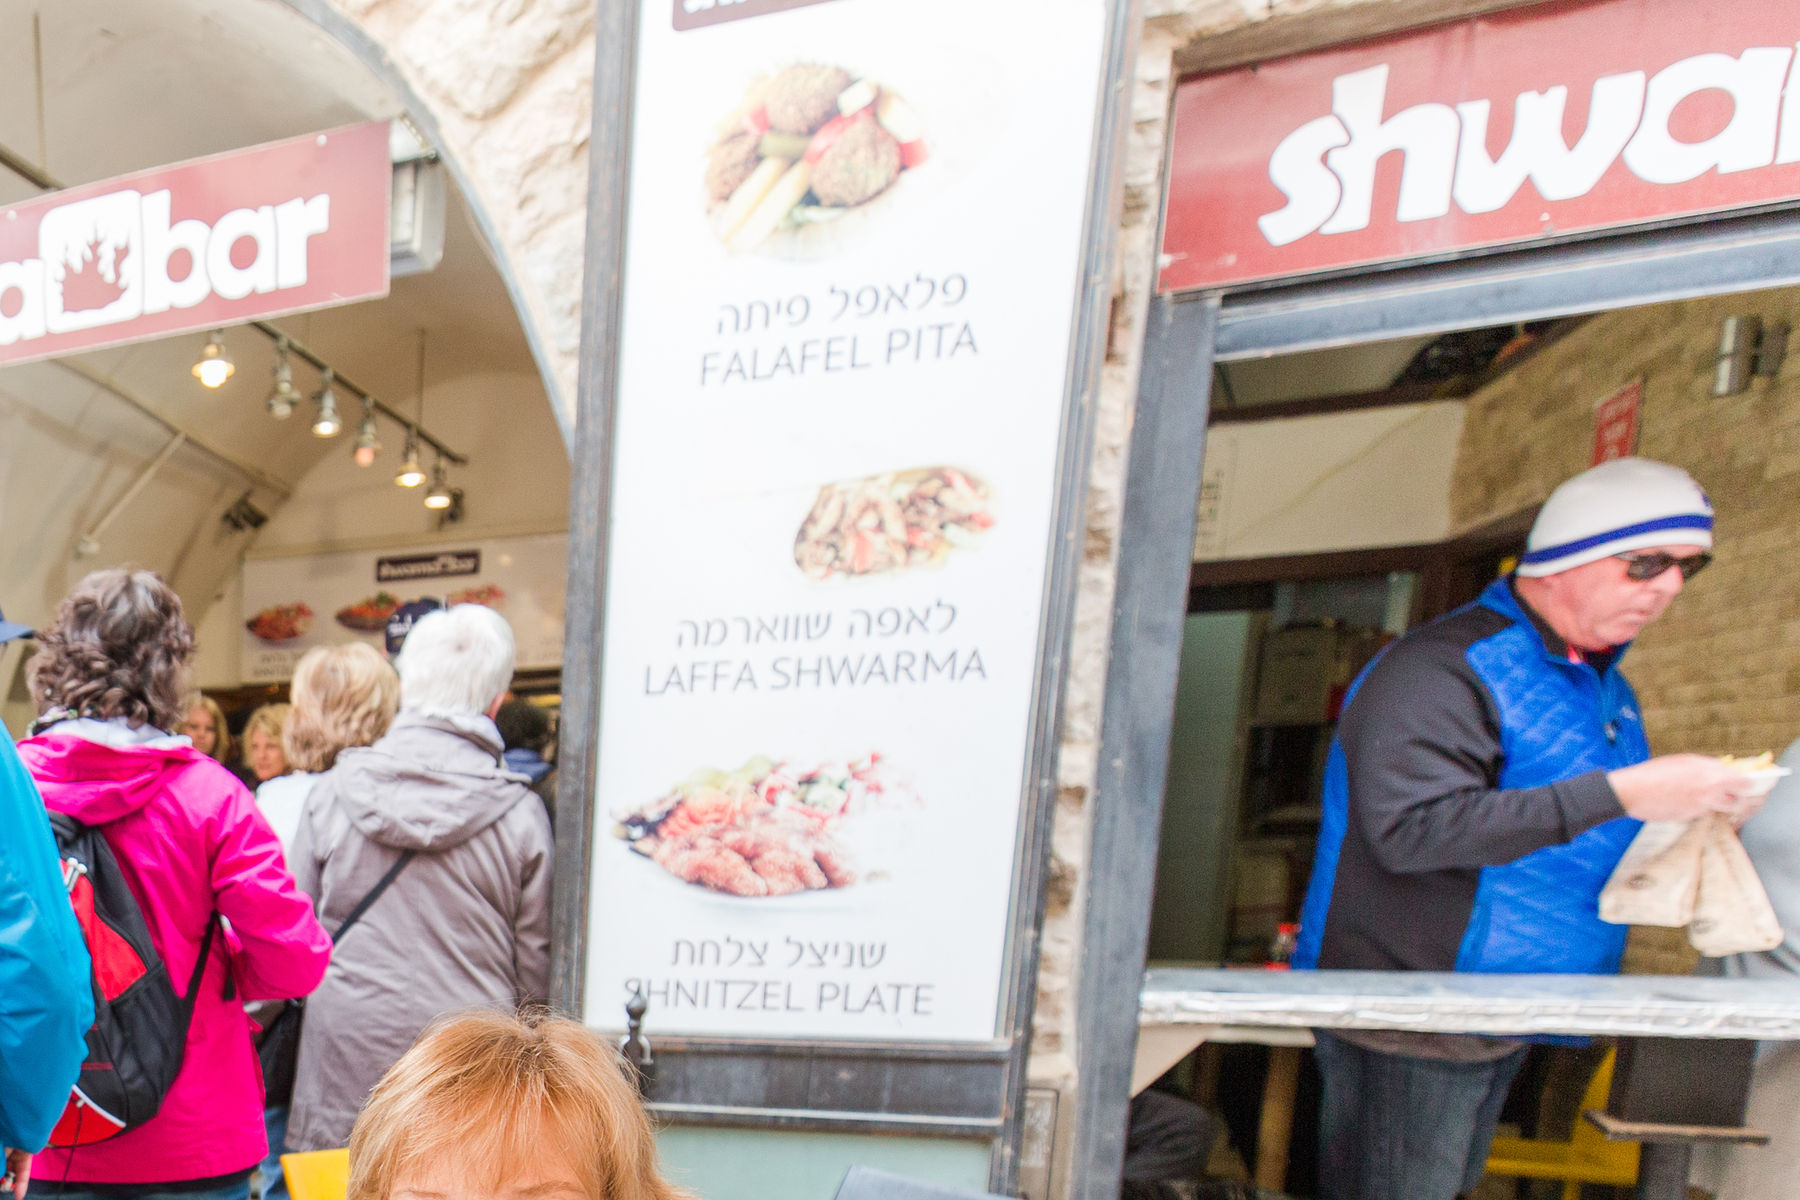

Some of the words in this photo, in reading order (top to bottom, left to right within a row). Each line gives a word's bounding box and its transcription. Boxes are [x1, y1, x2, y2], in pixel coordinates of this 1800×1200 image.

[143, 190, 330, 313] bar
[715, 294, 813, 336] פיתה
[830, 271, 969, 321] פלאפל
[699, 334, 872, 388] FALAFEL
[885, 321, 980, 366] PITA
[675, 610, 833, 651] שווארמה
[848, 598, 958, 639] לאפה
[642, 659, 758, 697] LAFFA
[770, 647, 988, 690] SHWARMA
[670, 935, 768, 967] צלחת
[786, 936, 888, 969] שניצל
[817, 981, 935, 1016] PLATE
